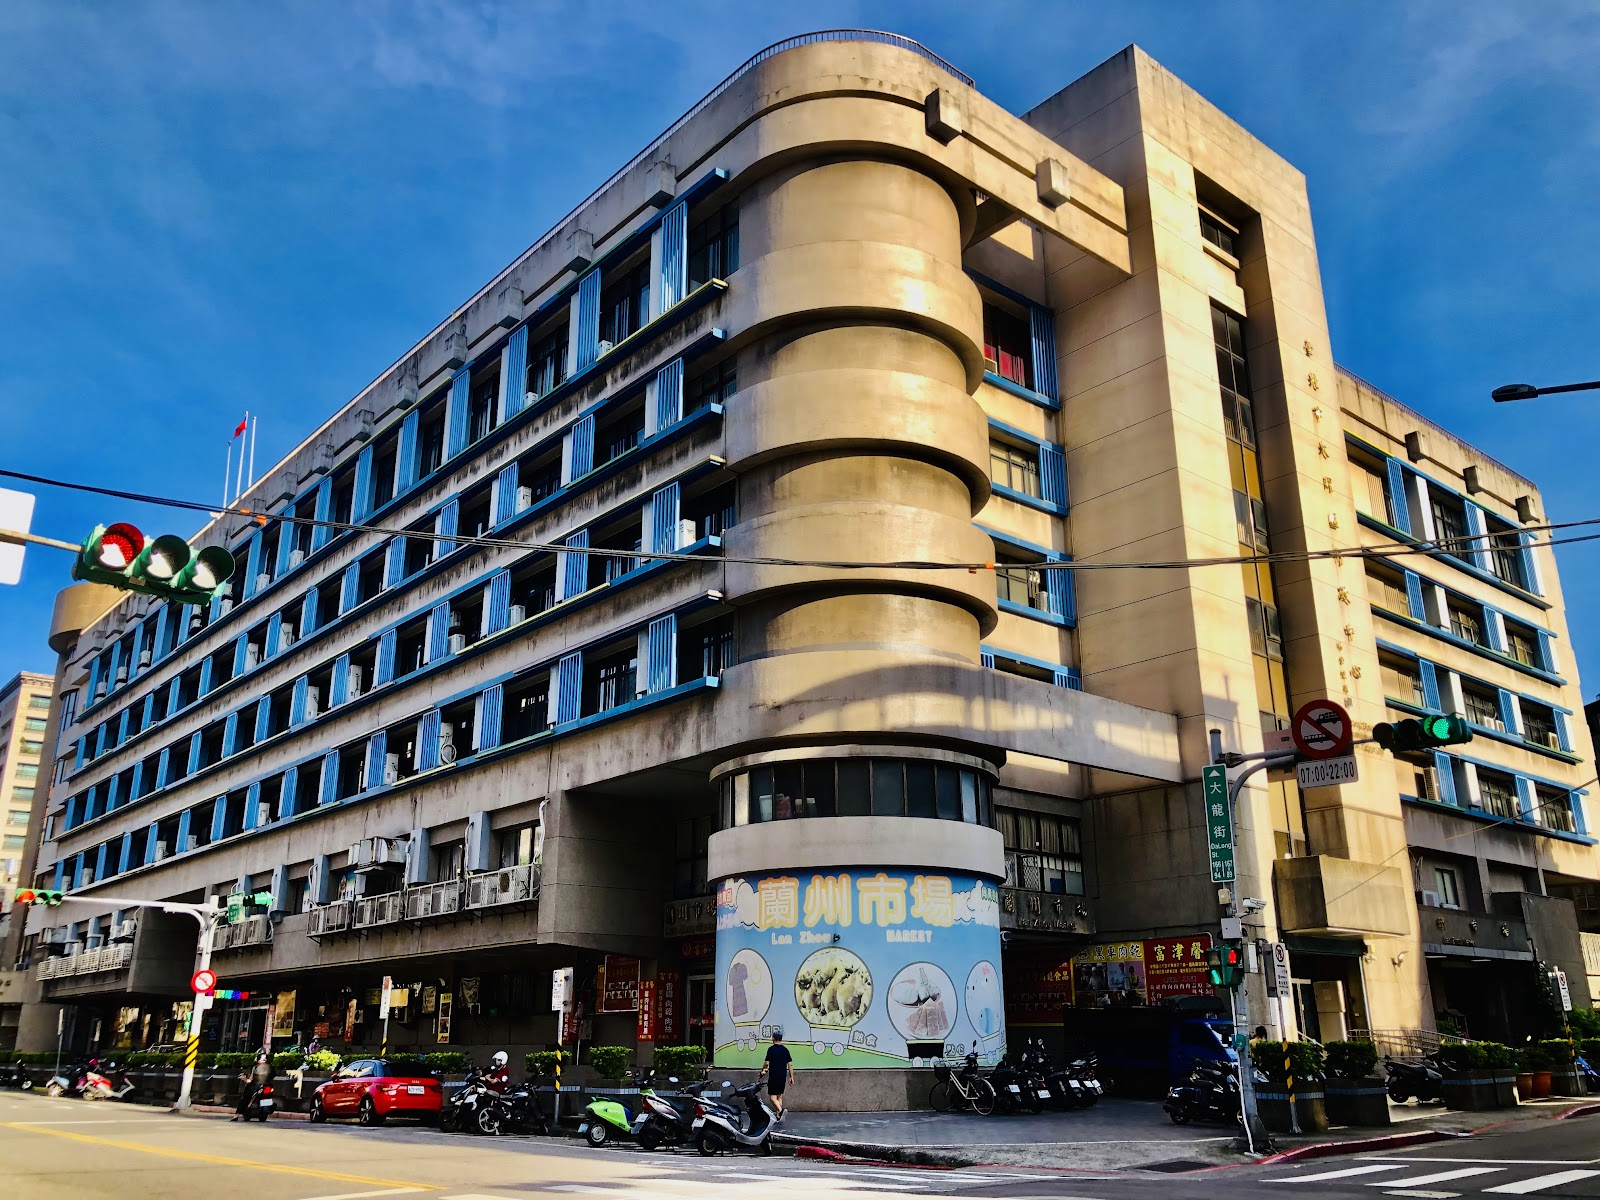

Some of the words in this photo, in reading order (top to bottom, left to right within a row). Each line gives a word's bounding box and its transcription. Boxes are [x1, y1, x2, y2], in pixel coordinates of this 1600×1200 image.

[1300, 761, 1355, 784] 07:00-22:00
[1210, 782, 1227, 839] 大龍街
[758, 872, 955, 928] 蘭州市場
[771, 932, 793, 945] Lan
[799, 931, 832, 944] Zhou
[886, 929, 933, 943] MARKET
[852, 1029, 878, 1047] 熱食
